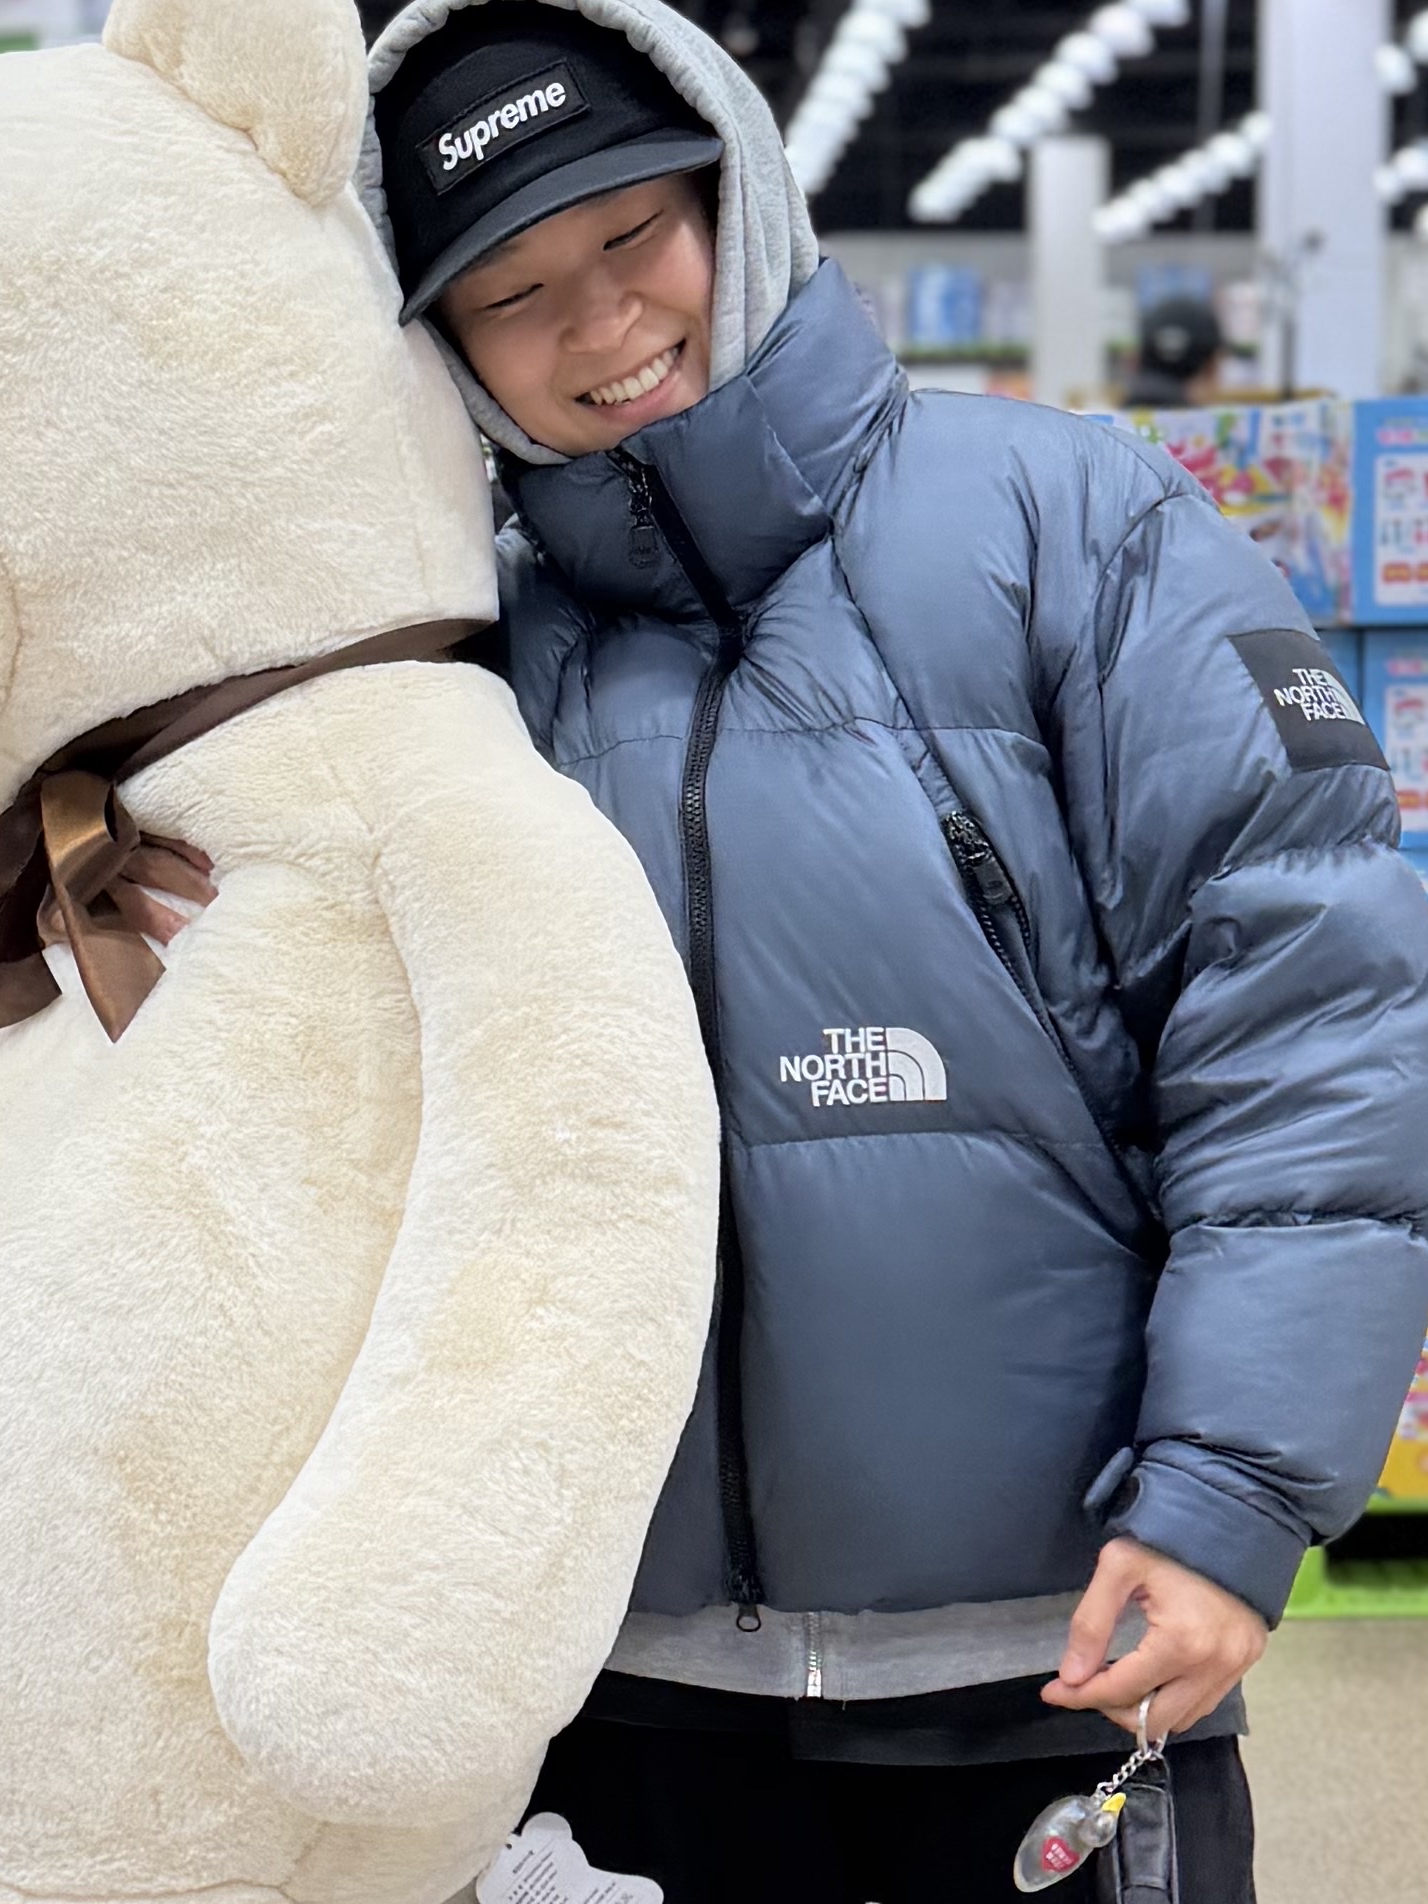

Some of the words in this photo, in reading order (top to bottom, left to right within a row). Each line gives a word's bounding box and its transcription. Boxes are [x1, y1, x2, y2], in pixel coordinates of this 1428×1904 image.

[439, 82, 567, 171] Supreme
[1292, 668, 1328, 686] THE
[1274, 685, 1337, 707] NORTH
[1301, 702, 1347, 722] FACE
[823, 1027, 885, 1054] THE
[780, 1052, 887, 1083] NORTH
[811, 1077, 889, 1108] FACE
